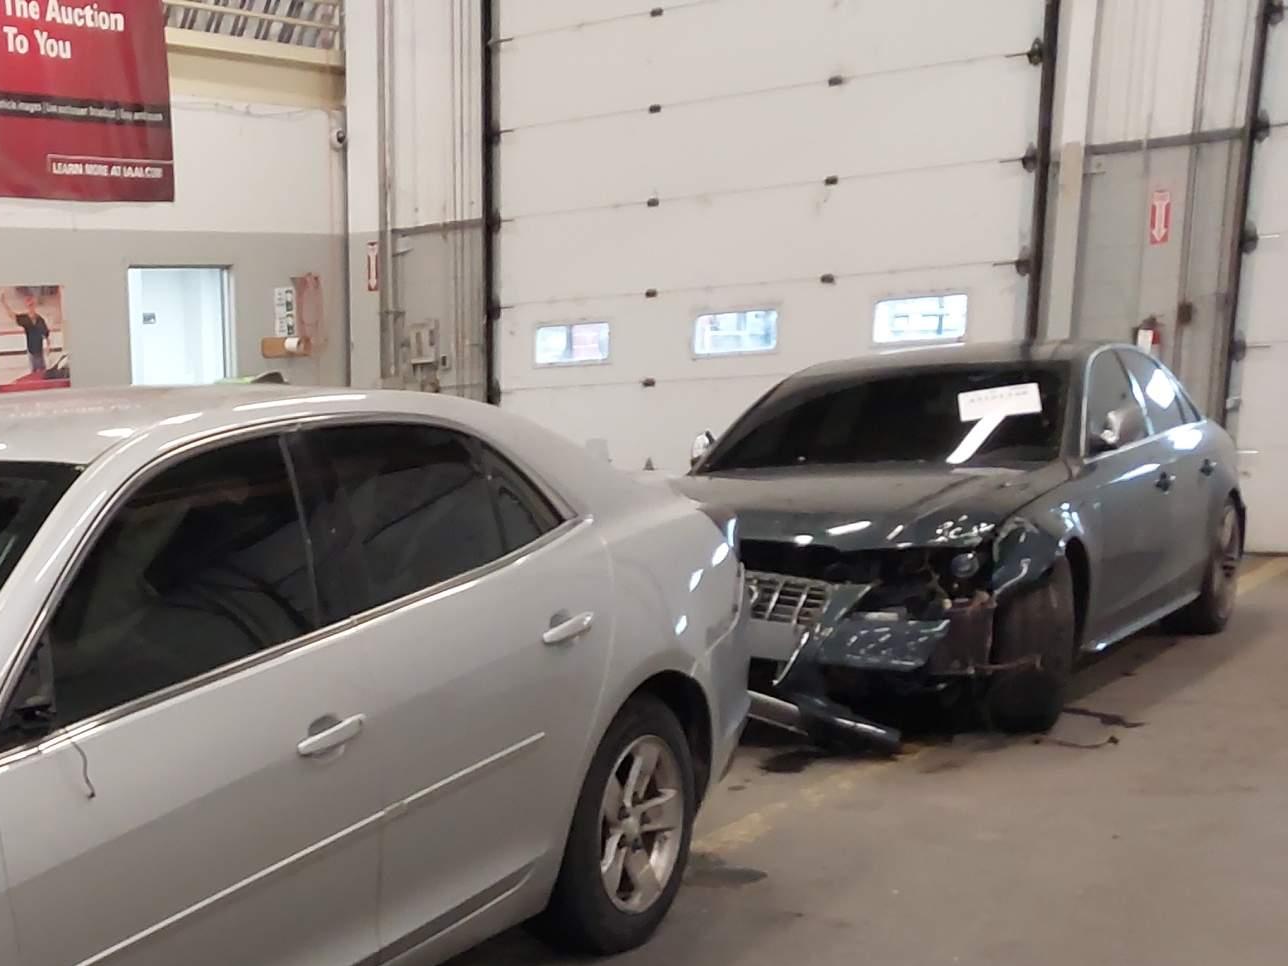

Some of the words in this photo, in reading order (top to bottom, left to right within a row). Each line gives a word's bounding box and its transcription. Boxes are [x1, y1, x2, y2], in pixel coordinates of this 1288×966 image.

[5, 0, 40, 20] The
[46, 0, 124, 31] Auction
[3, 26, 29, 54] To
[34, 30, 71, 59] You
[52, 162, 83, 175] LEARN
[85, 163, 108, 176] MORE
[111, 165, 121, 176] AT
